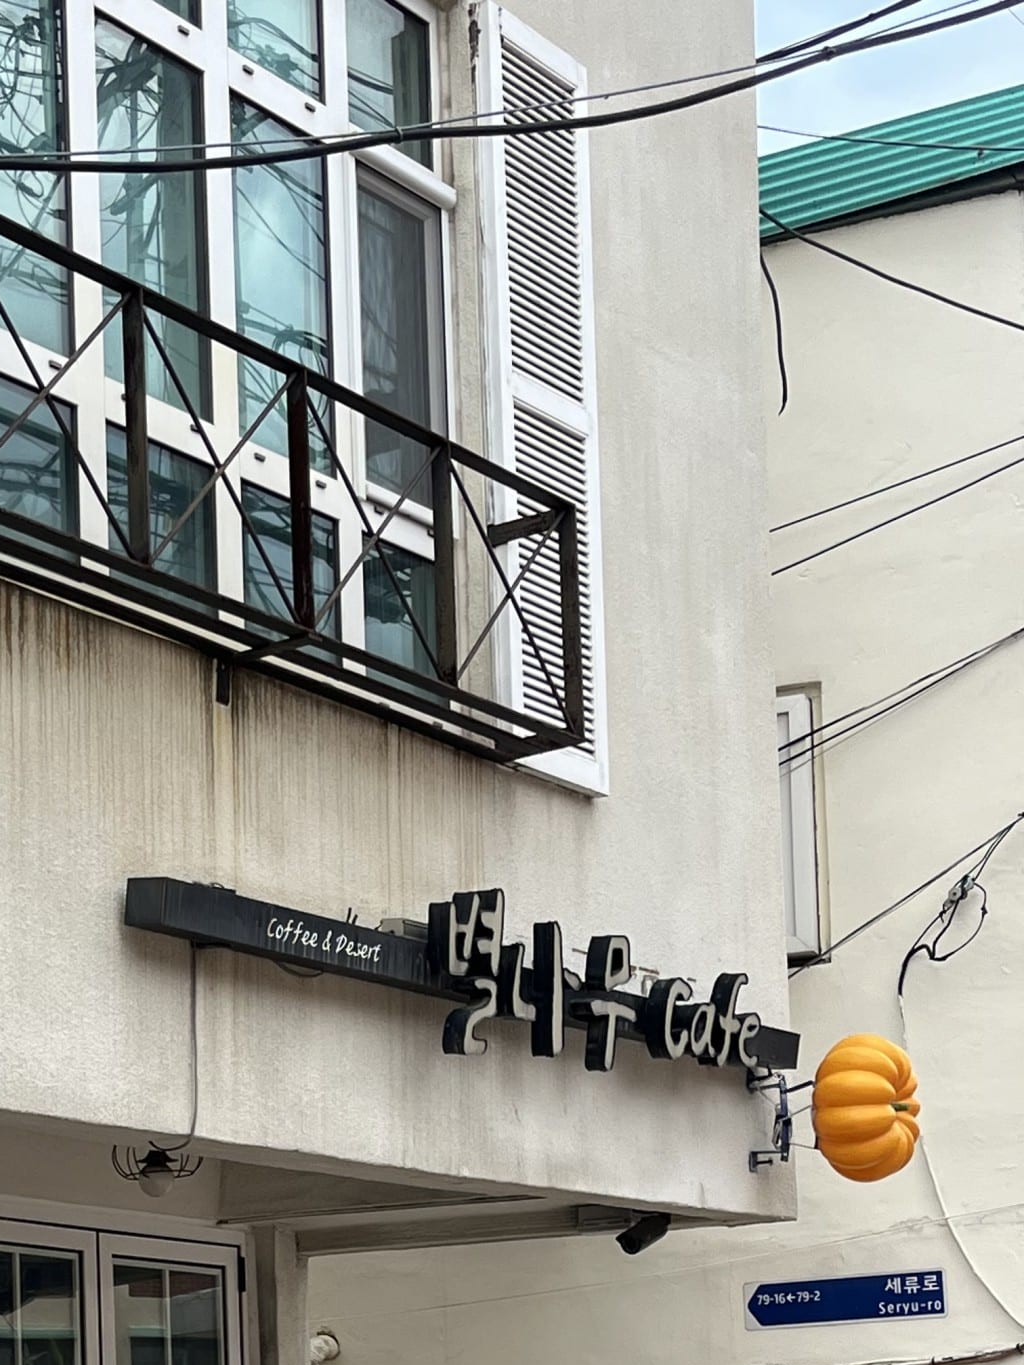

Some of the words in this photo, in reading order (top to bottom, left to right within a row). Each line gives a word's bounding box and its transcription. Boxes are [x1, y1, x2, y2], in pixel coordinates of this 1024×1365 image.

[266, 917, 318, 948] Coffee
[321, 929, 333, 952] &
[335, 933, 382, 963] Desert
[432, 888, 638, 1071] 별나무
[655, 973, 762, 1068] Cafe
[884, 1274, 940, 1295] 세류로
[756, 1292, 786, 1306] 79-16
[796, 1290, 821, 1302] 79-2
[878, 1300, 943, 1315] Seryu-ro
